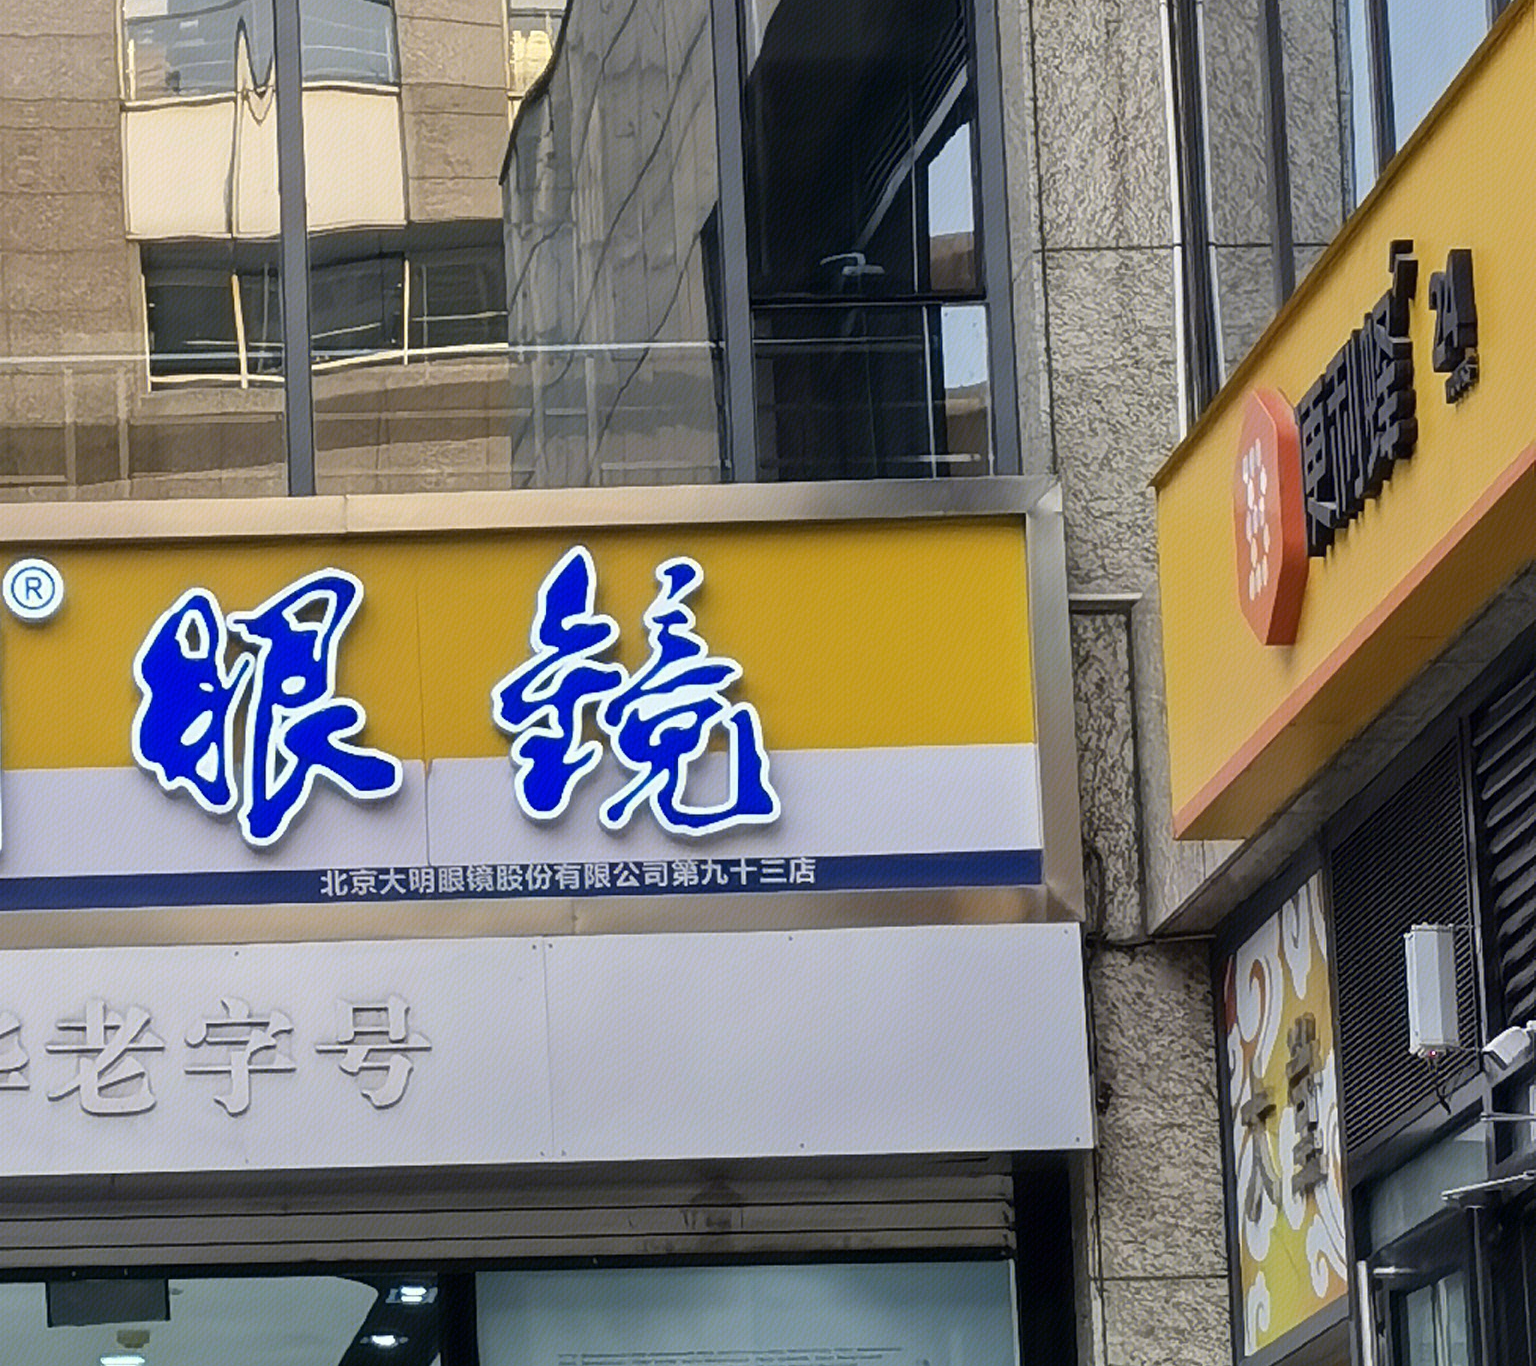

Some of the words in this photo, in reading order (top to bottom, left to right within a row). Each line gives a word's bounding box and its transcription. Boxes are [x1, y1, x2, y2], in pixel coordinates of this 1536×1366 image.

[320, 856, 817, 898] 北京大明眼镜股份有限公司第九十三店
